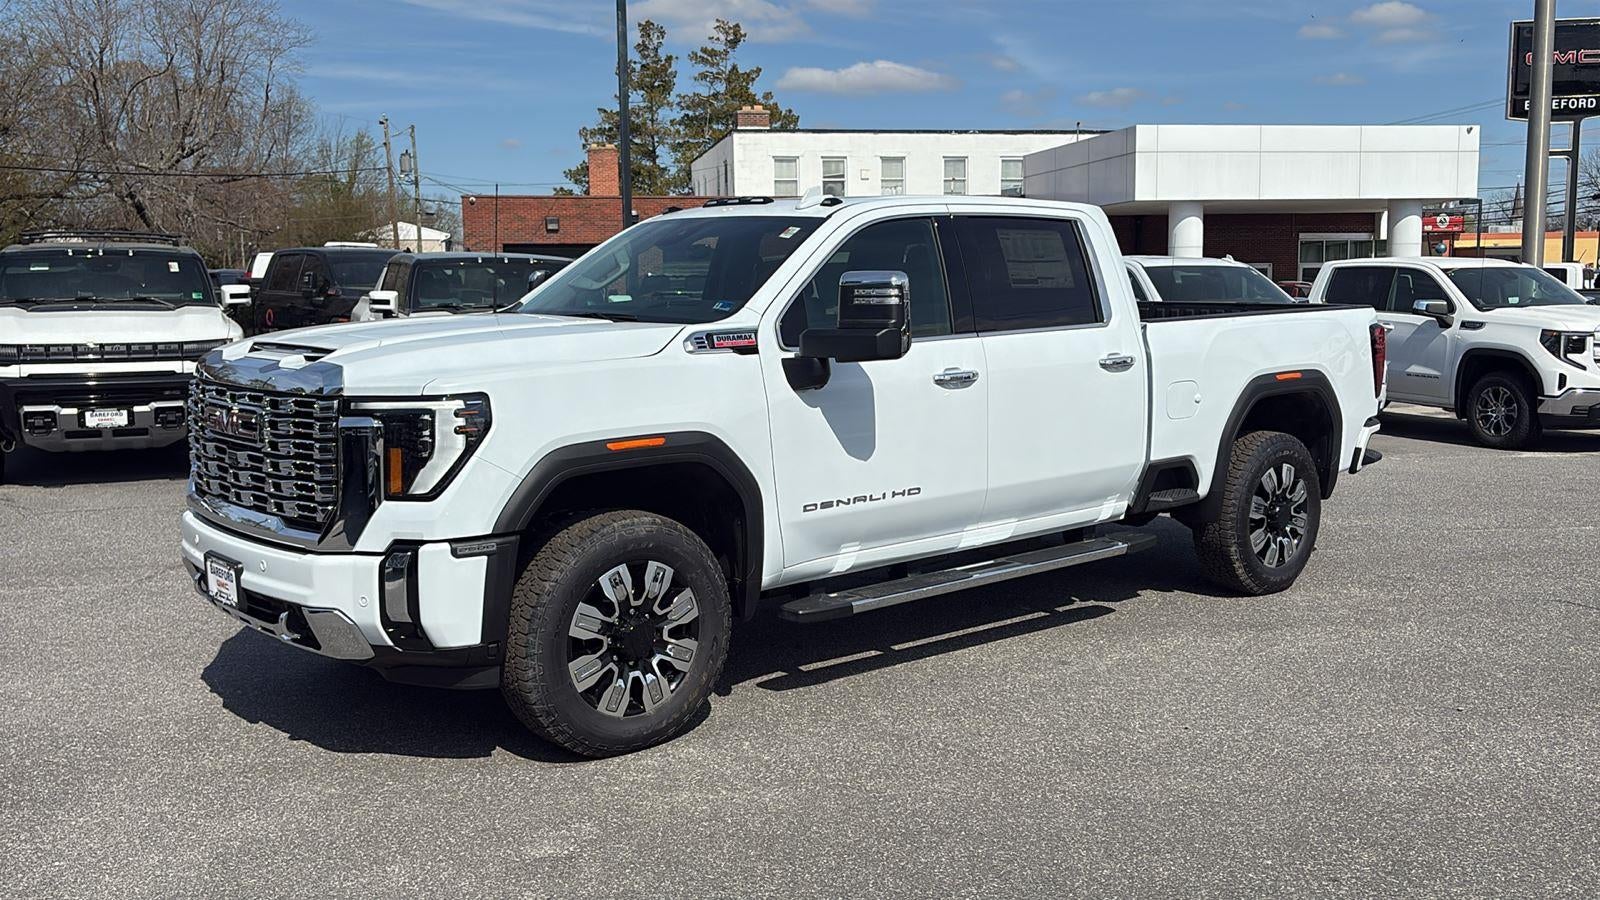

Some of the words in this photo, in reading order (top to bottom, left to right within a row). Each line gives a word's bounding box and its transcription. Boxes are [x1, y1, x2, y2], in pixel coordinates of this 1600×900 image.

[1526, 49, 1600, 65] MC
[1524, 98, 1597, 111] BEFORD
[716, 334, 753, 342] DURAMAX
[205, 406, 257, 440] GMC
[803, 492, 886, 513] DENALI
[891, 487, 921, 499] HD
[457, 542, 496, 554] 2500
[210, 561, 234, 583] BAREFORD
